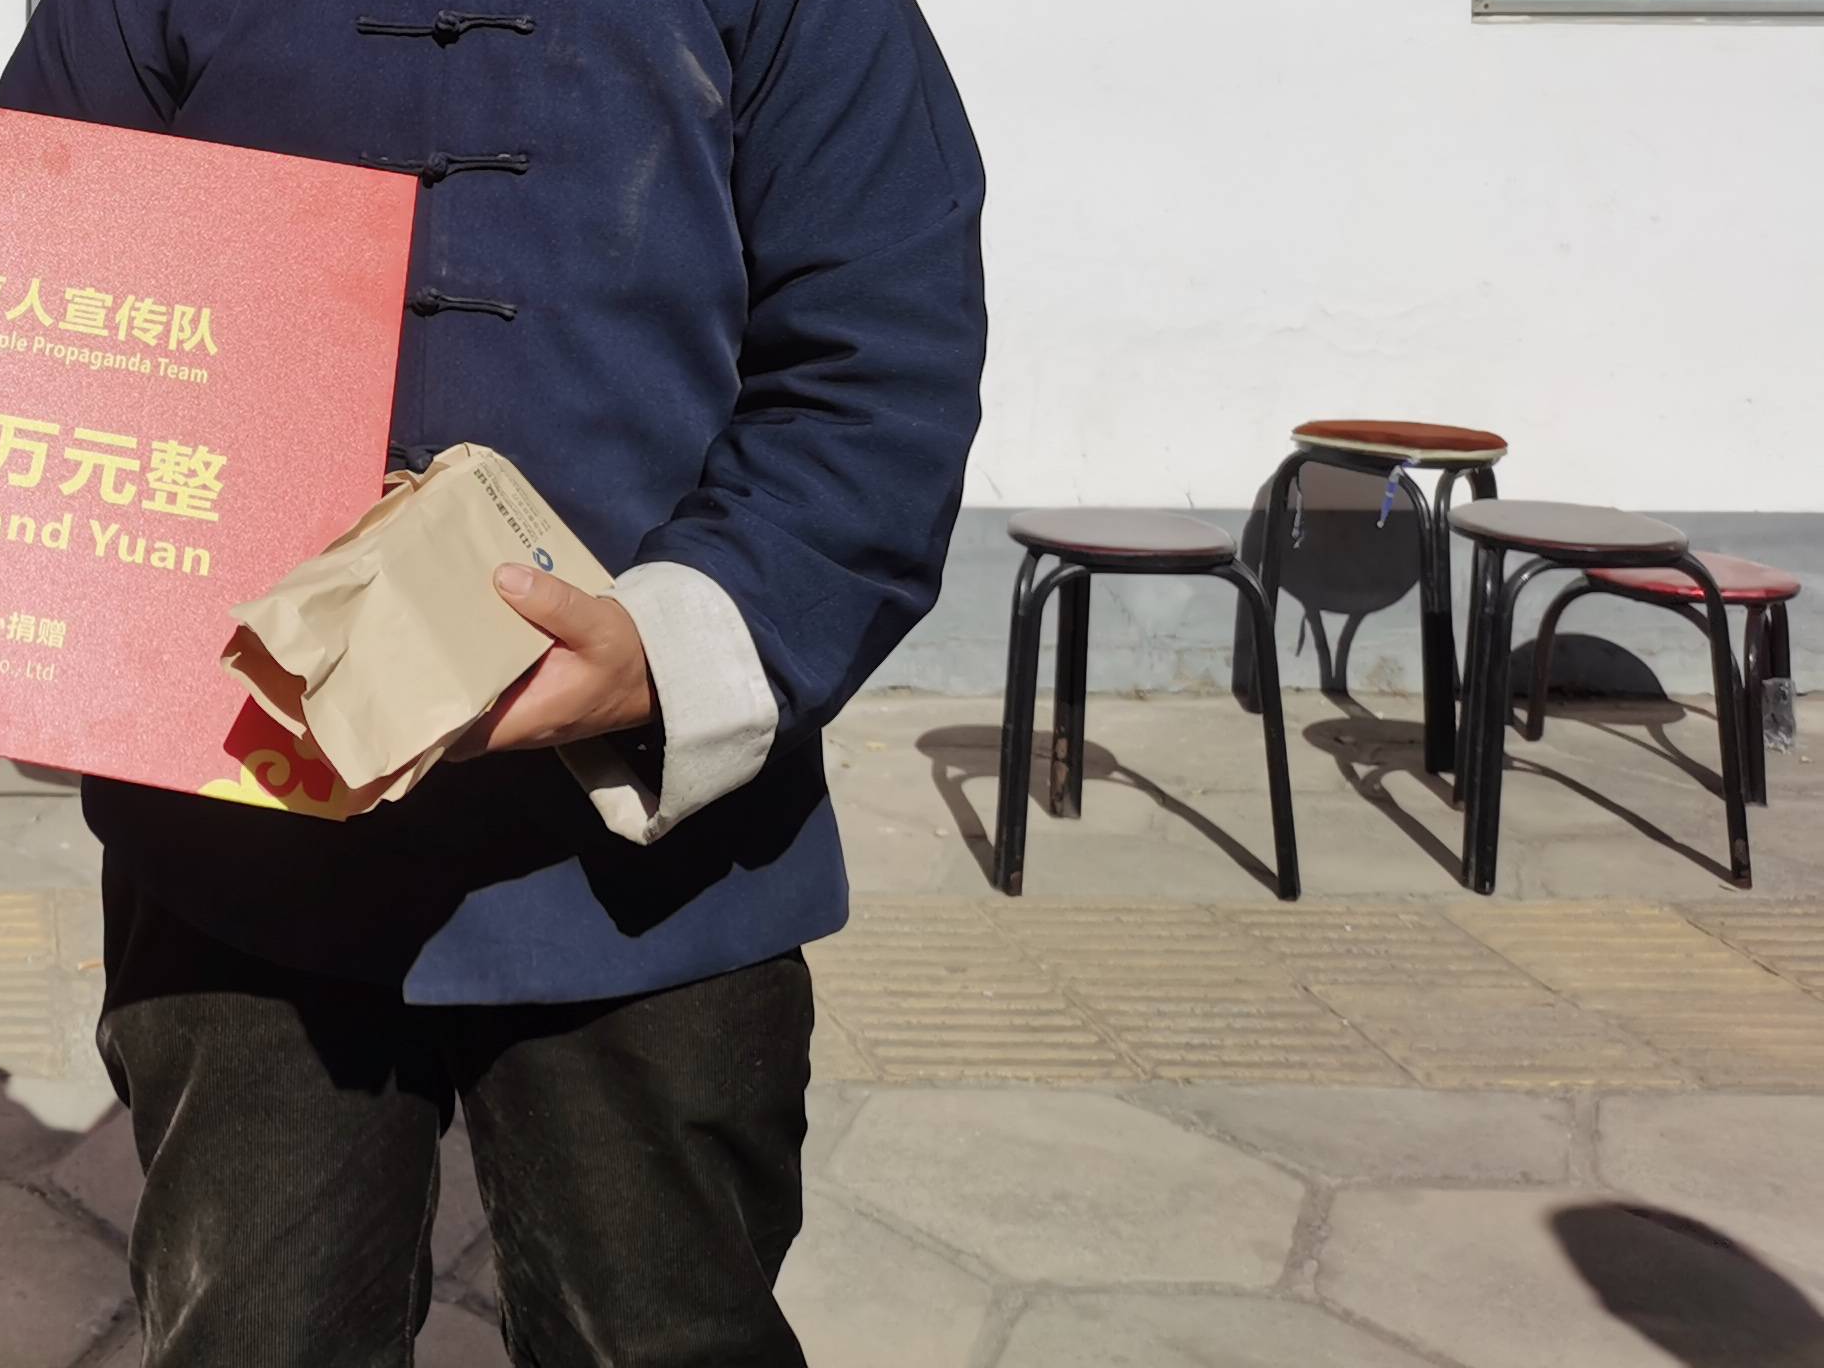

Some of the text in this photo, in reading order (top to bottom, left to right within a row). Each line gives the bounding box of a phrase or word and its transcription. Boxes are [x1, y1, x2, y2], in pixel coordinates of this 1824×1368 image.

[32, 336, 152, 373] Propaganda
[157, 356, 209, 384] Team
[88, 518, 211, 577] Yuan
